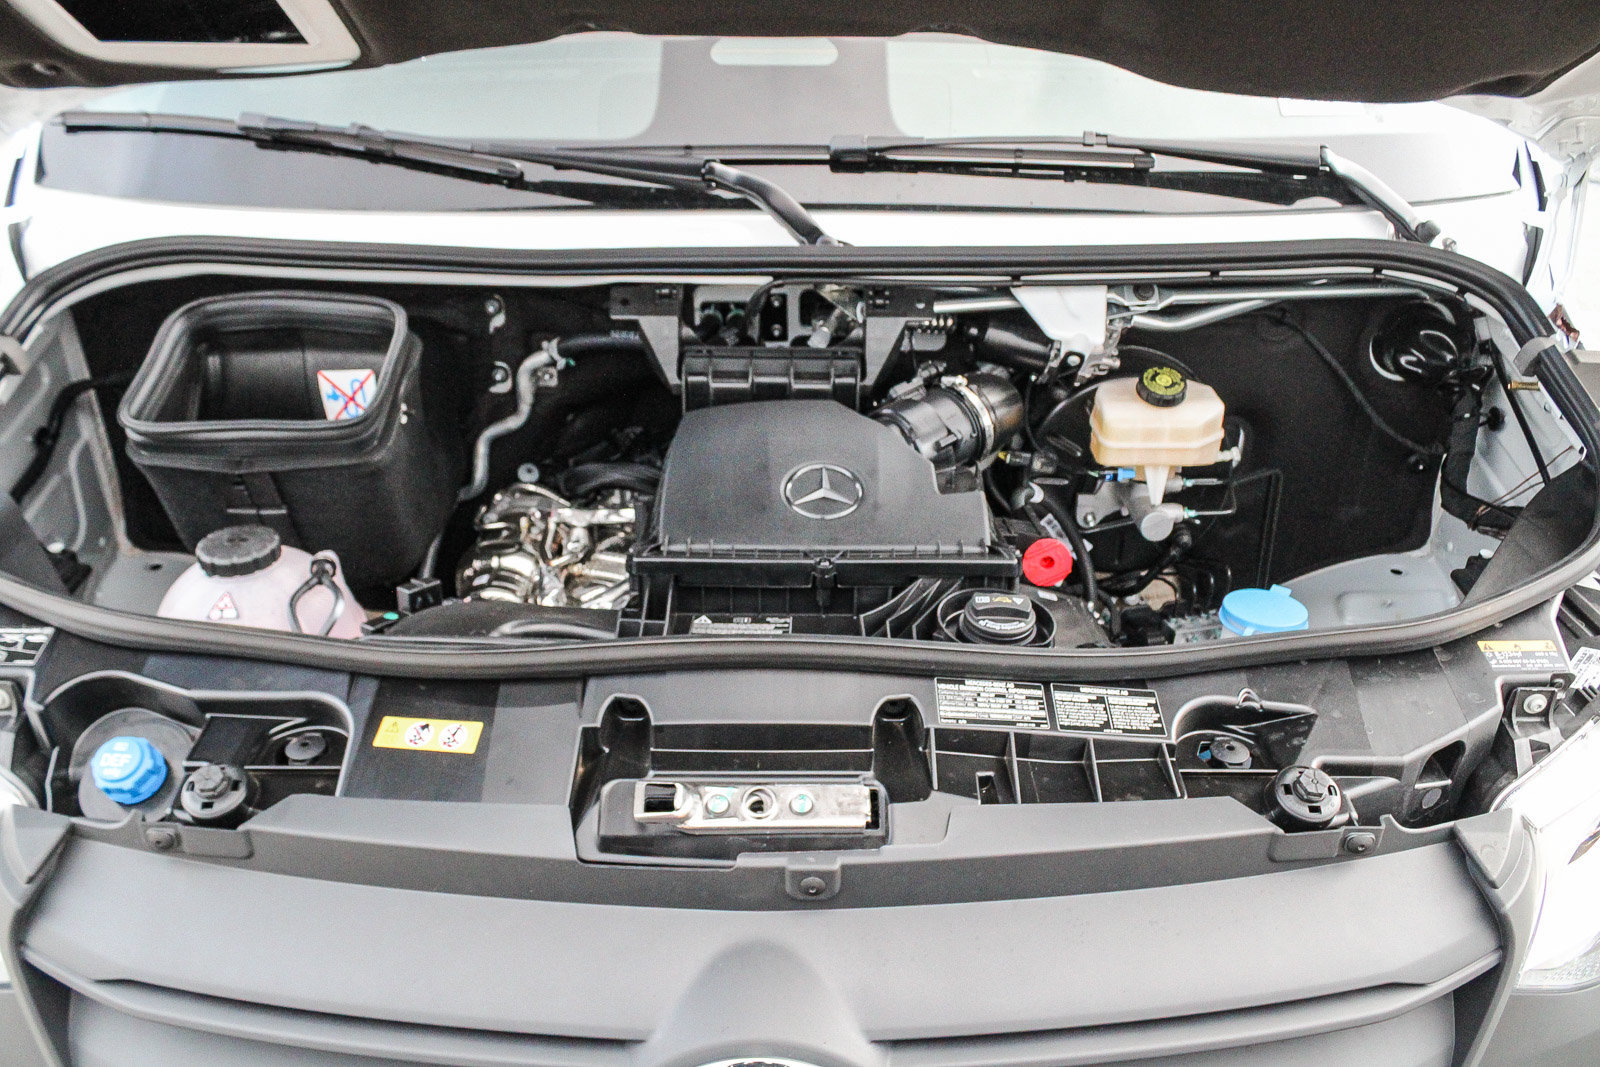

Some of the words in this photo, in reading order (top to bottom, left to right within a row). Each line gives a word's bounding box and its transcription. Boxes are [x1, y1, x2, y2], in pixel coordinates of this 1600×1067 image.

[937, 683, 959, 691] VEHICLE
[959, 684, 984, 692] EMISSION
[984, 686, 1007, 694] CONTROL
[1007, 687, 1043, 697] INFORMATION
[100, 752, 132, 767] DEF
